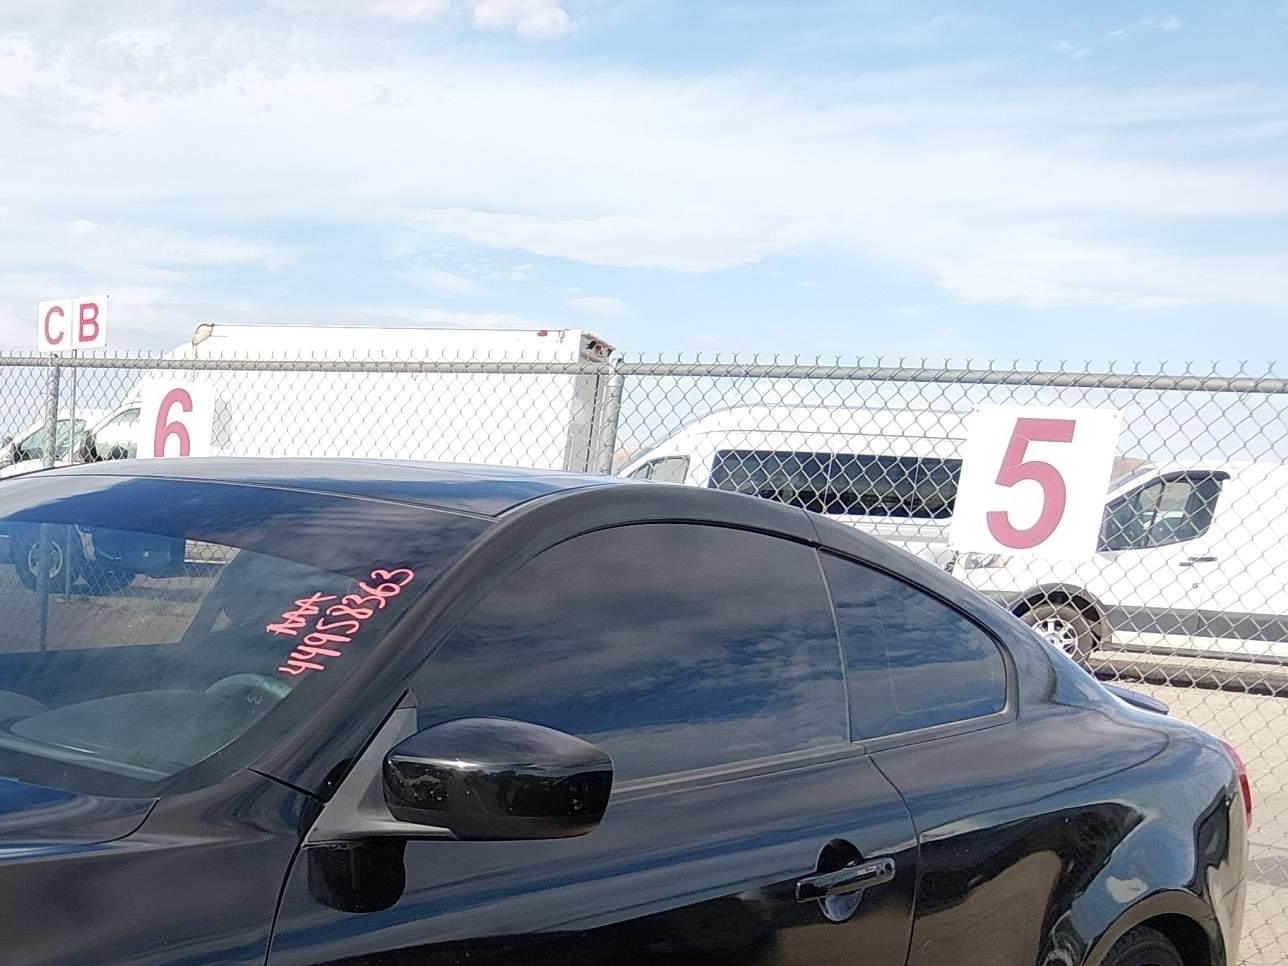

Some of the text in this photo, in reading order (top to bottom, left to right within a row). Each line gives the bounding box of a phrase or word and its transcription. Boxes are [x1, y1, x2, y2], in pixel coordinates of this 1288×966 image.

[44, 302, 100, 345] C B
[153, 387, 193, 458] 6
[986, 417, 1076, 550] 5
[276, 567, 416, 677] 44958363
